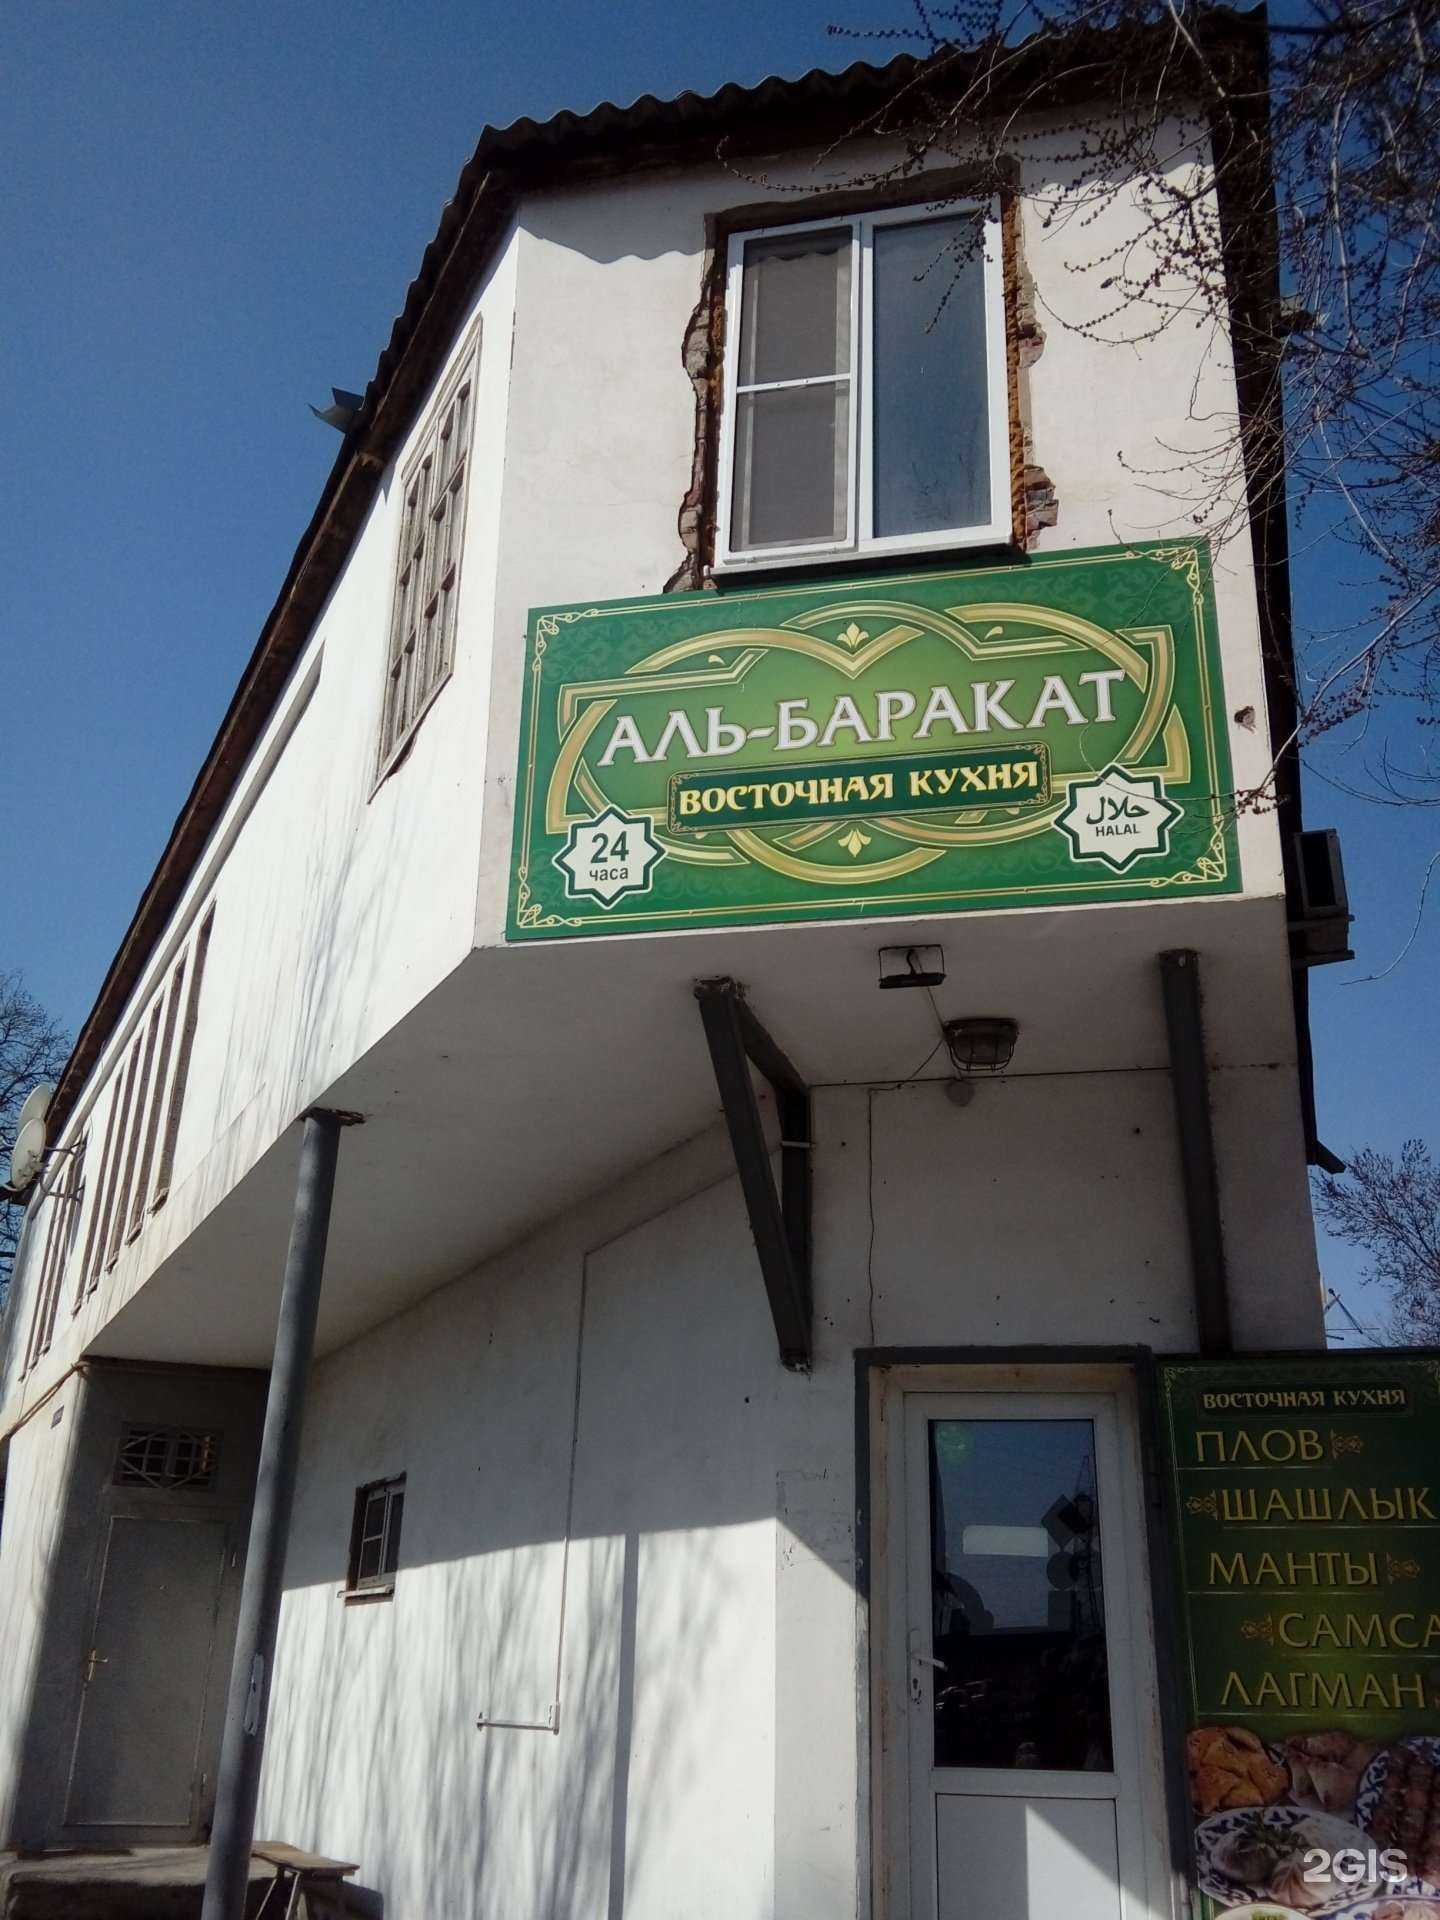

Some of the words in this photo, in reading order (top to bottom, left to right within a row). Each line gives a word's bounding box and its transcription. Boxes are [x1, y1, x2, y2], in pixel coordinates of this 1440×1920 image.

[597, 670, 1125, 766] АЛЬ-БАРАКАТ
[679, 773, 894, 815] ВОСТОЧНАЯ
[909, 761, 1038, 796] КУХНЯ
[1086, 796, 1150, 824] حلال
[591, 831, 629, 863] 24
[1096, 824, 1140, 837] HALAL
[589, 867, 629, 881] часа
[1203, 1391, 1325, 1409] ВОСТОЧНАЯ
[1333, 1389, 1406, 1407] КУХНЯ
[1195, 1429, 1324, 1462] ПЛОВ
[1221, 1487, 1438, 1521] ШАШЛЫК
[1208, 1552, 1379, 1585] МАНТЫ
[1220, 1671, 1426, 1708] ЛАГМАН
